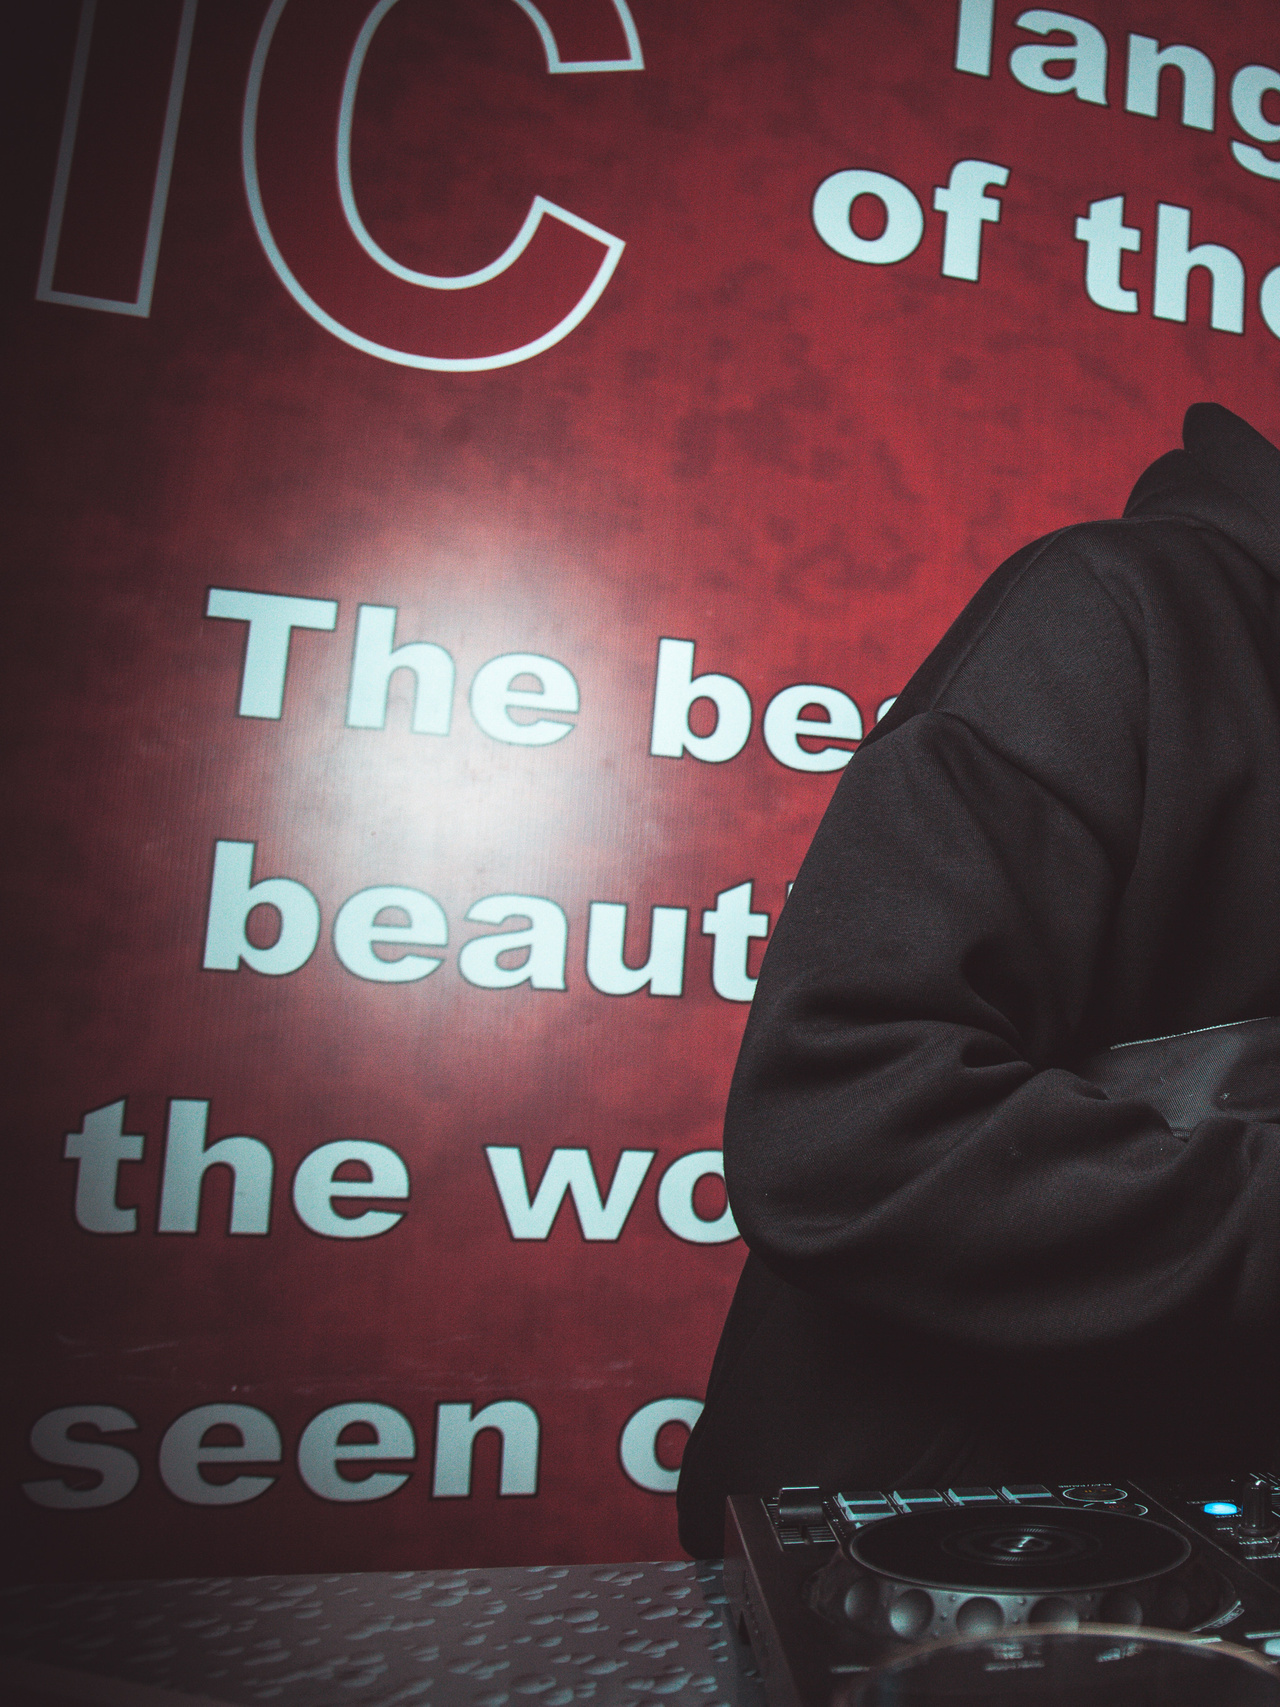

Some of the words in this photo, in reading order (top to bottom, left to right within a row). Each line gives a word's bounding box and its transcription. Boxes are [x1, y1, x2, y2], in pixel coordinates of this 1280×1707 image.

[811, 159, 1011, 283] of
[206, 587, 581, 746] The
[650, 637, 900, 773] be
[203, 840, 795, 1002] beaut
[63, 1098, 411, 1239] the
[485, 1144, 745, 1245] wo
[20, 1401, 541, 1509] seen
